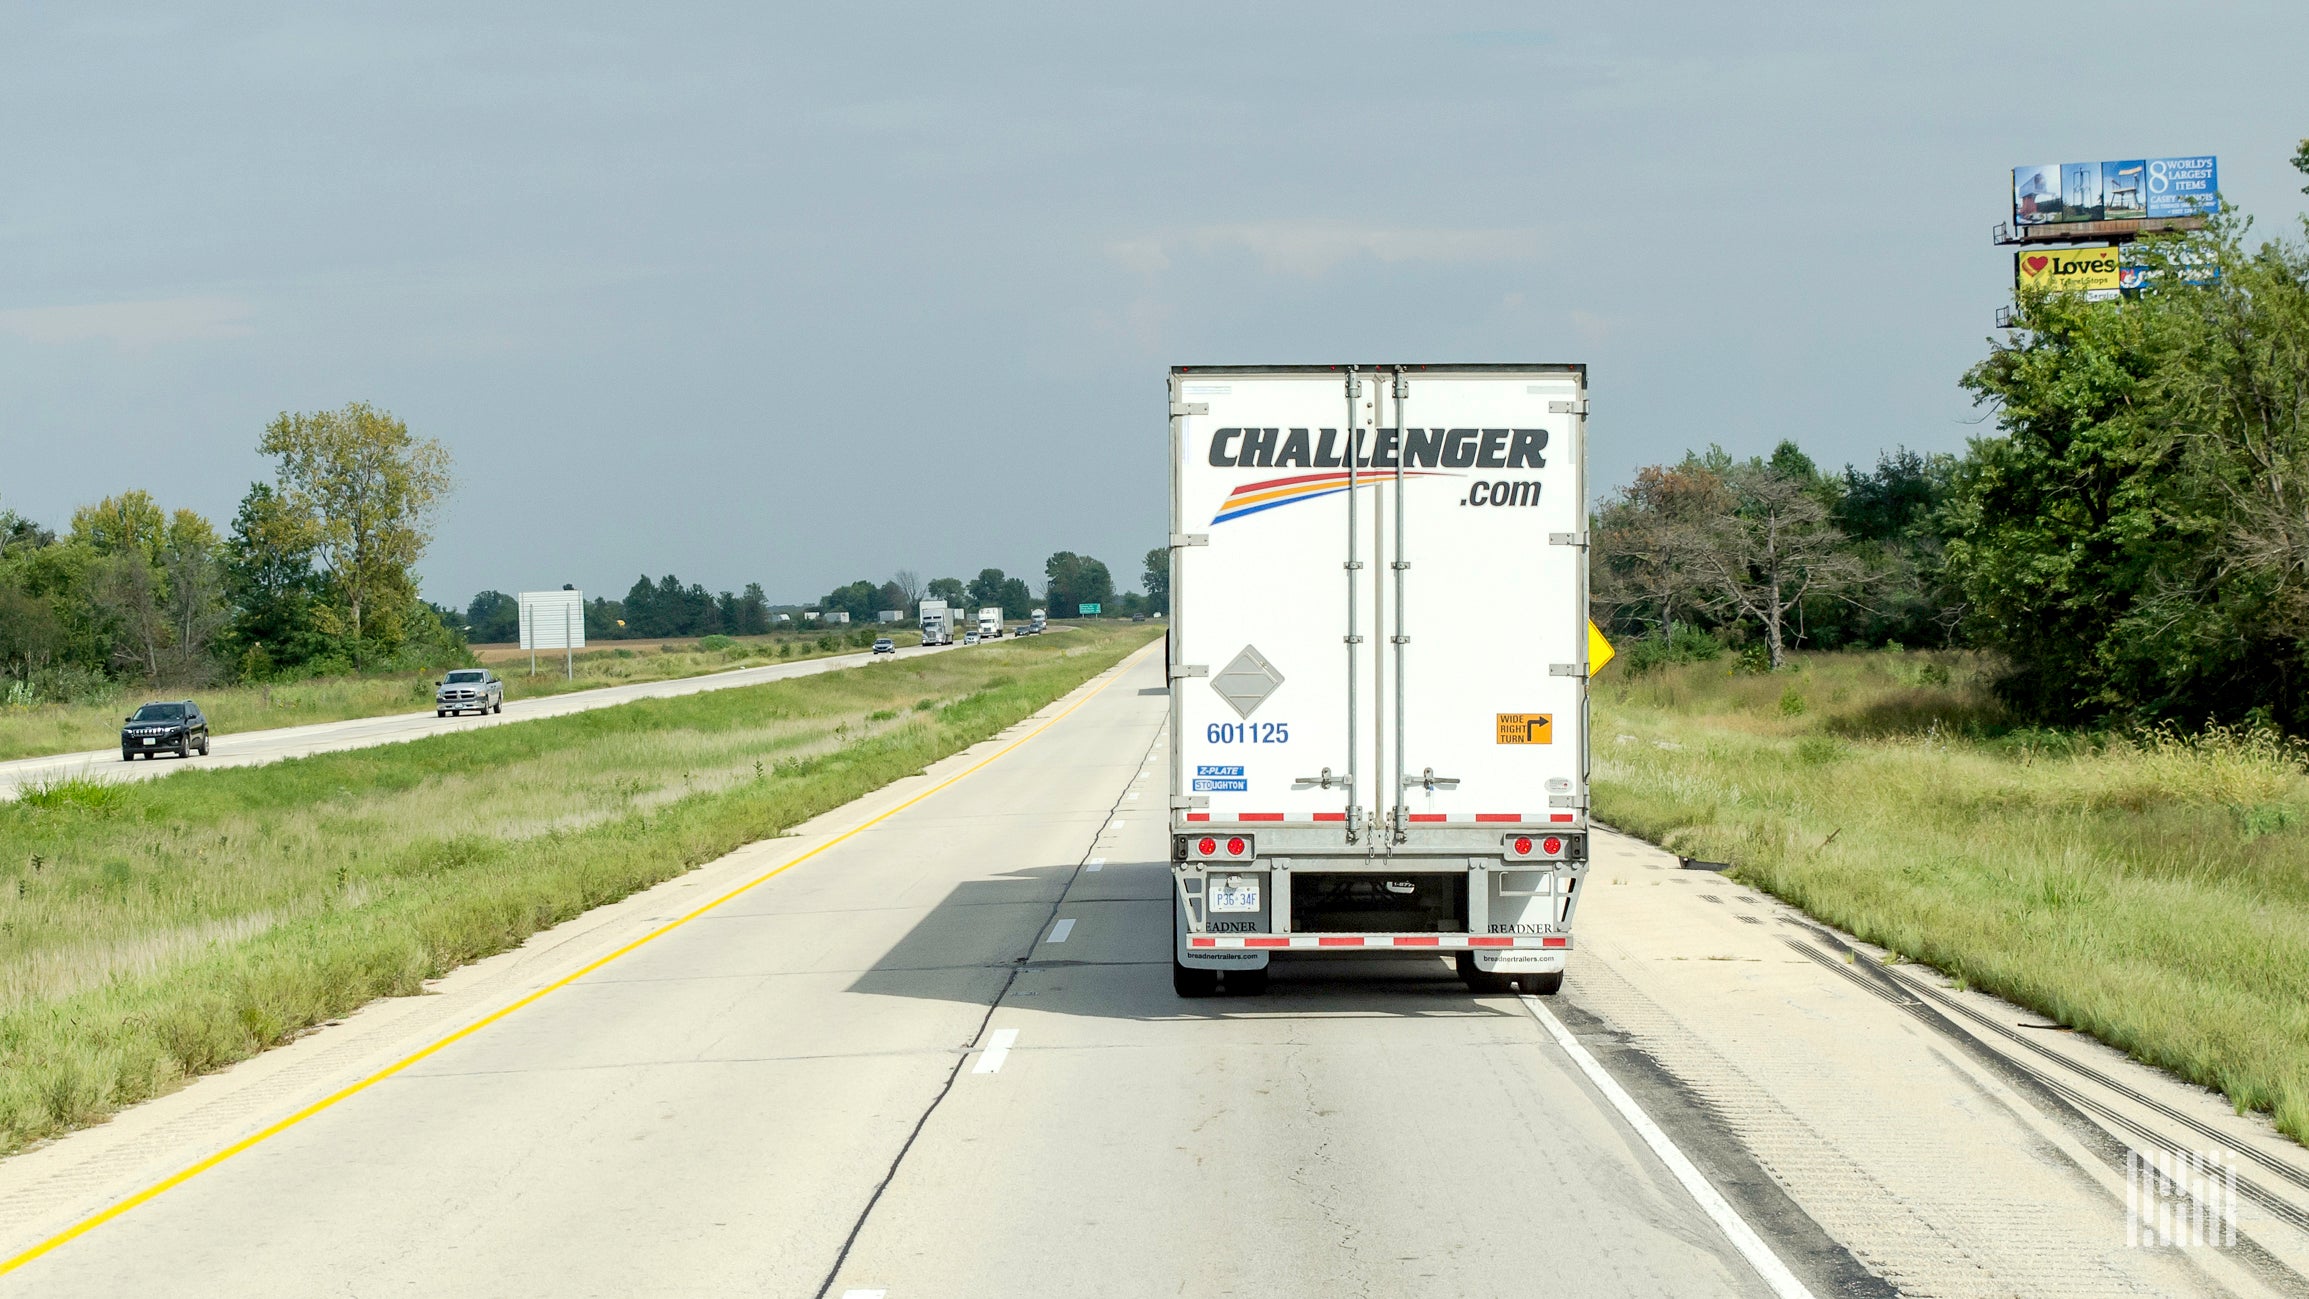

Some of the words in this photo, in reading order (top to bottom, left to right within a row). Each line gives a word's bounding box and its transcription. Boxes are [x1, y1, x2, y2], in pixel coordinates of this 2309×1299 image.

[2166, 158, 2213, 169] WORLD'S
[2149, 160, 2169, 194] 8
[2168, 169, 2213, 180] LARGEST
[2175, 180, 2207, 191] ITEMS
[1208, 428, 1549, 468] CHALLENGER
[1460, 480, 1542, 507] .com
[1500, 715, 1525, 724] WIDE
[1207, 721, 1289, 744] 601125
[1500, 724, 1527, 734] RIGHT
[1500, 734, 1525, 743] TURN
[1199, 767, 1239, 775] Z-PLATE
[1195, 780, 1245, 790] STOUGHTON
[1187, 921, 1257, 932] EADNER
[1187, 952, 1258, 960] breadnertrailers.com
[1483, 955, 1555, 963] breadnertrailers.com
